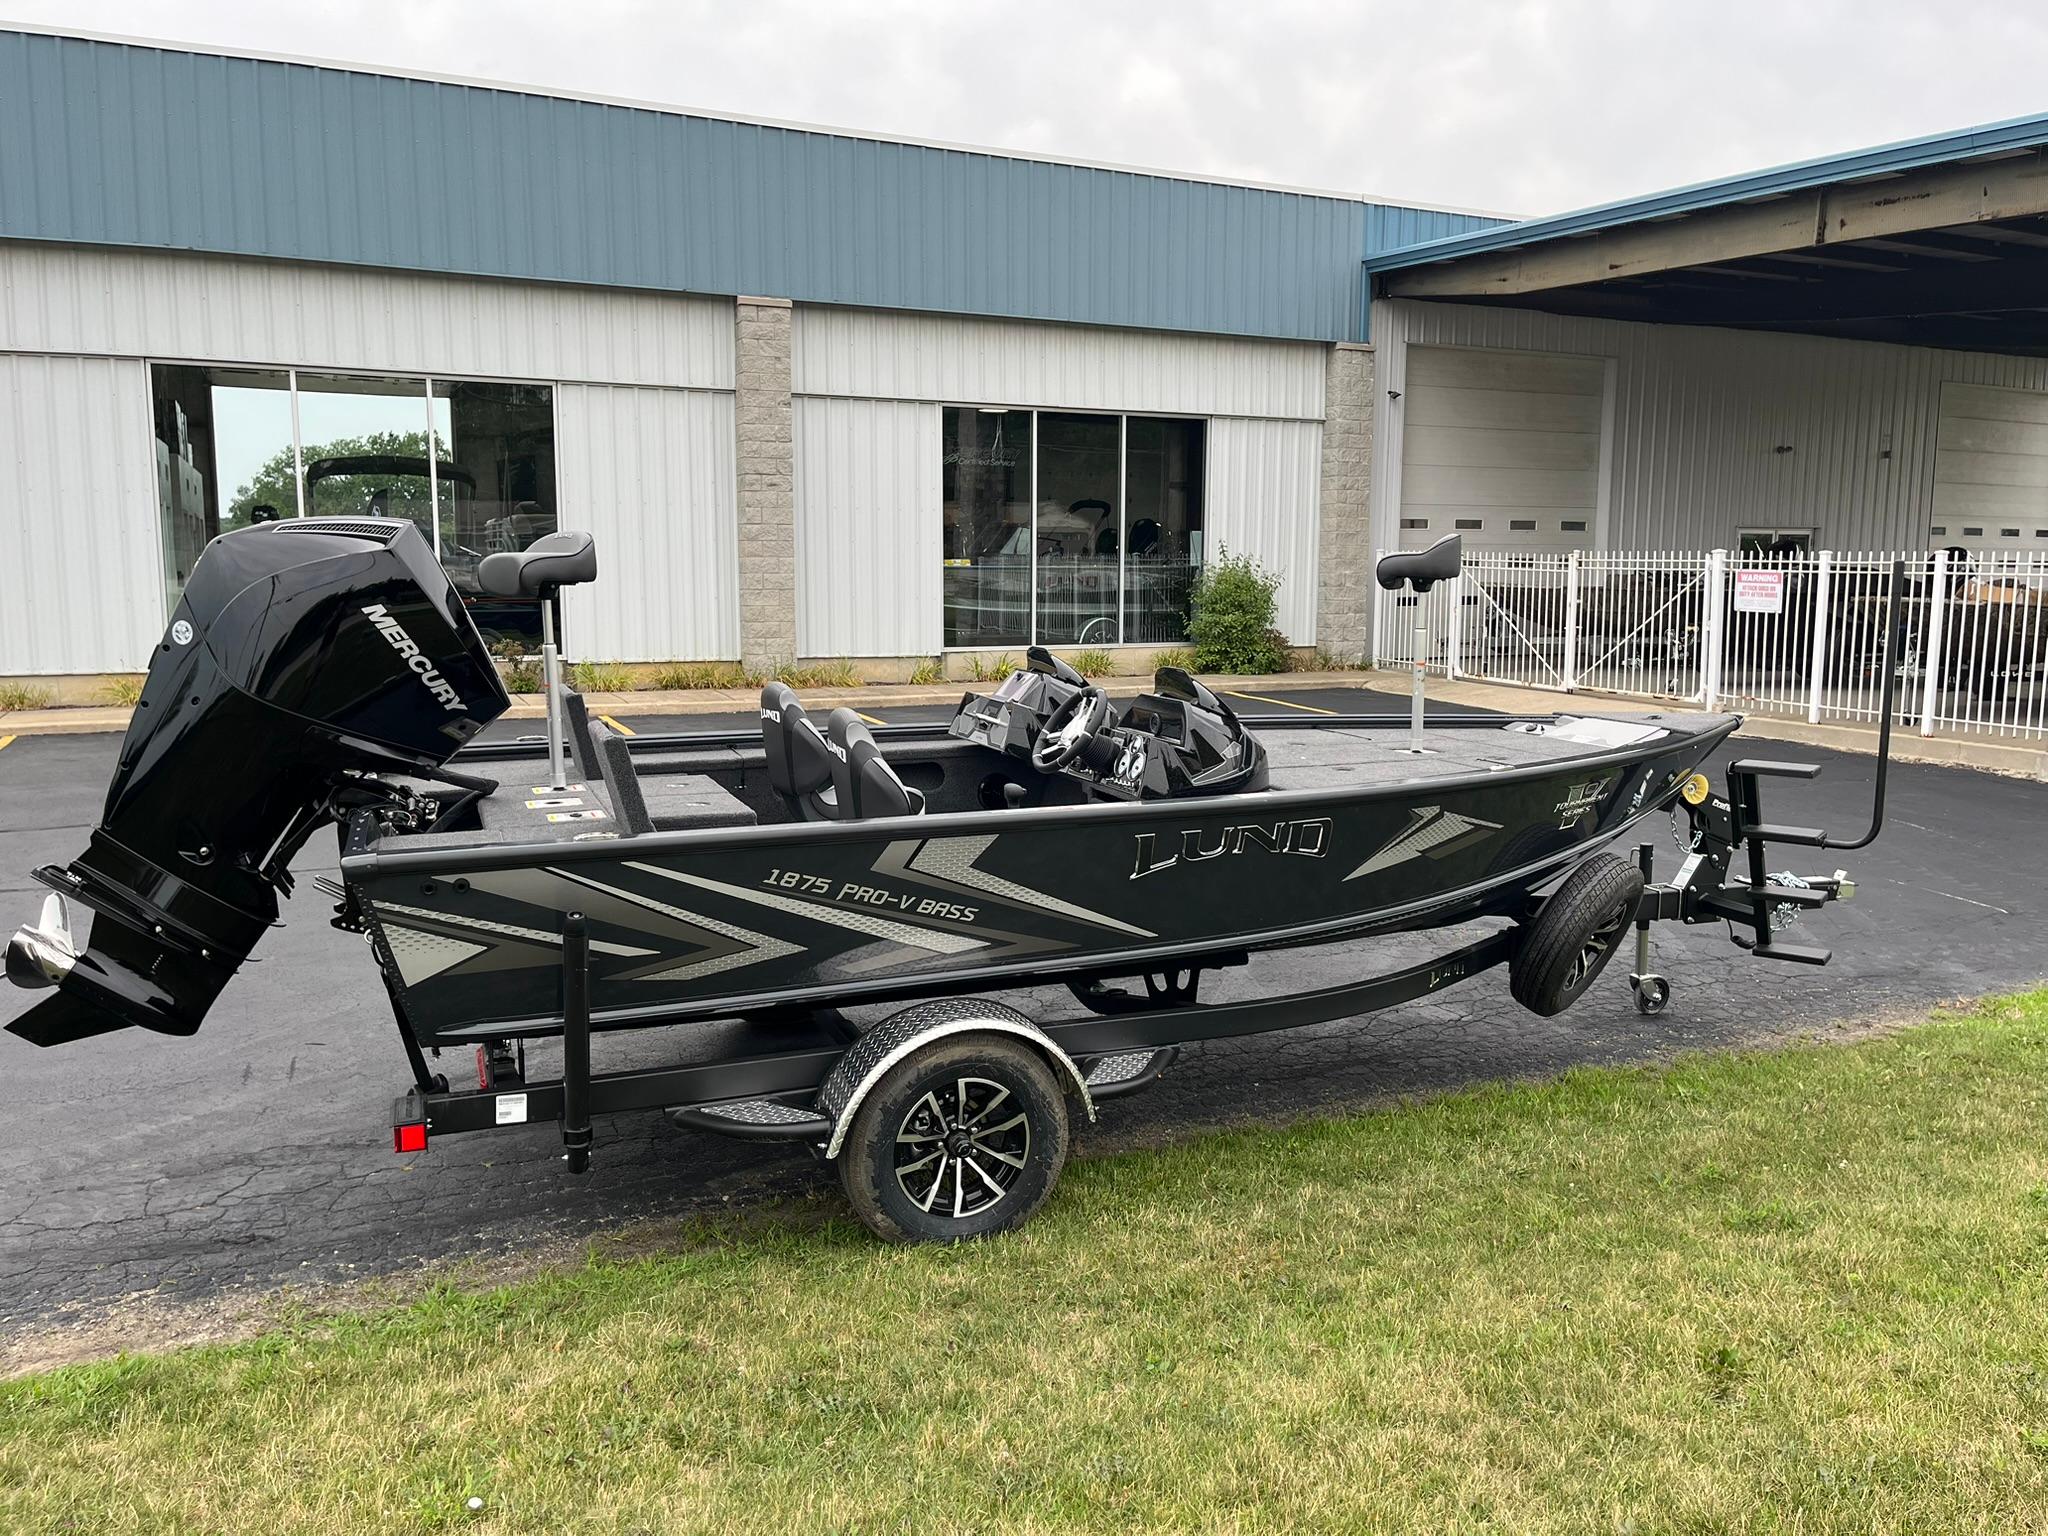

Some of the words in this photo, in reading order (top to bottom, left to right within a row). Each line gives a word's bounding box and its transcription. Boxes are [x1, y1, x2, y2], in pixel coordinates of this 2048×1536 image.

[1741, 573, 1779, 582] WARNING
[361, 604, 468, 711] MERCURY
[761, 708, 781, 724] LUND
[1129, 817, 1333, 881] LUND
[762, 868, 833, 894] 1875
[836, 883, 915, 909] PRO-V
[916, 898, 979, 922] BASS
